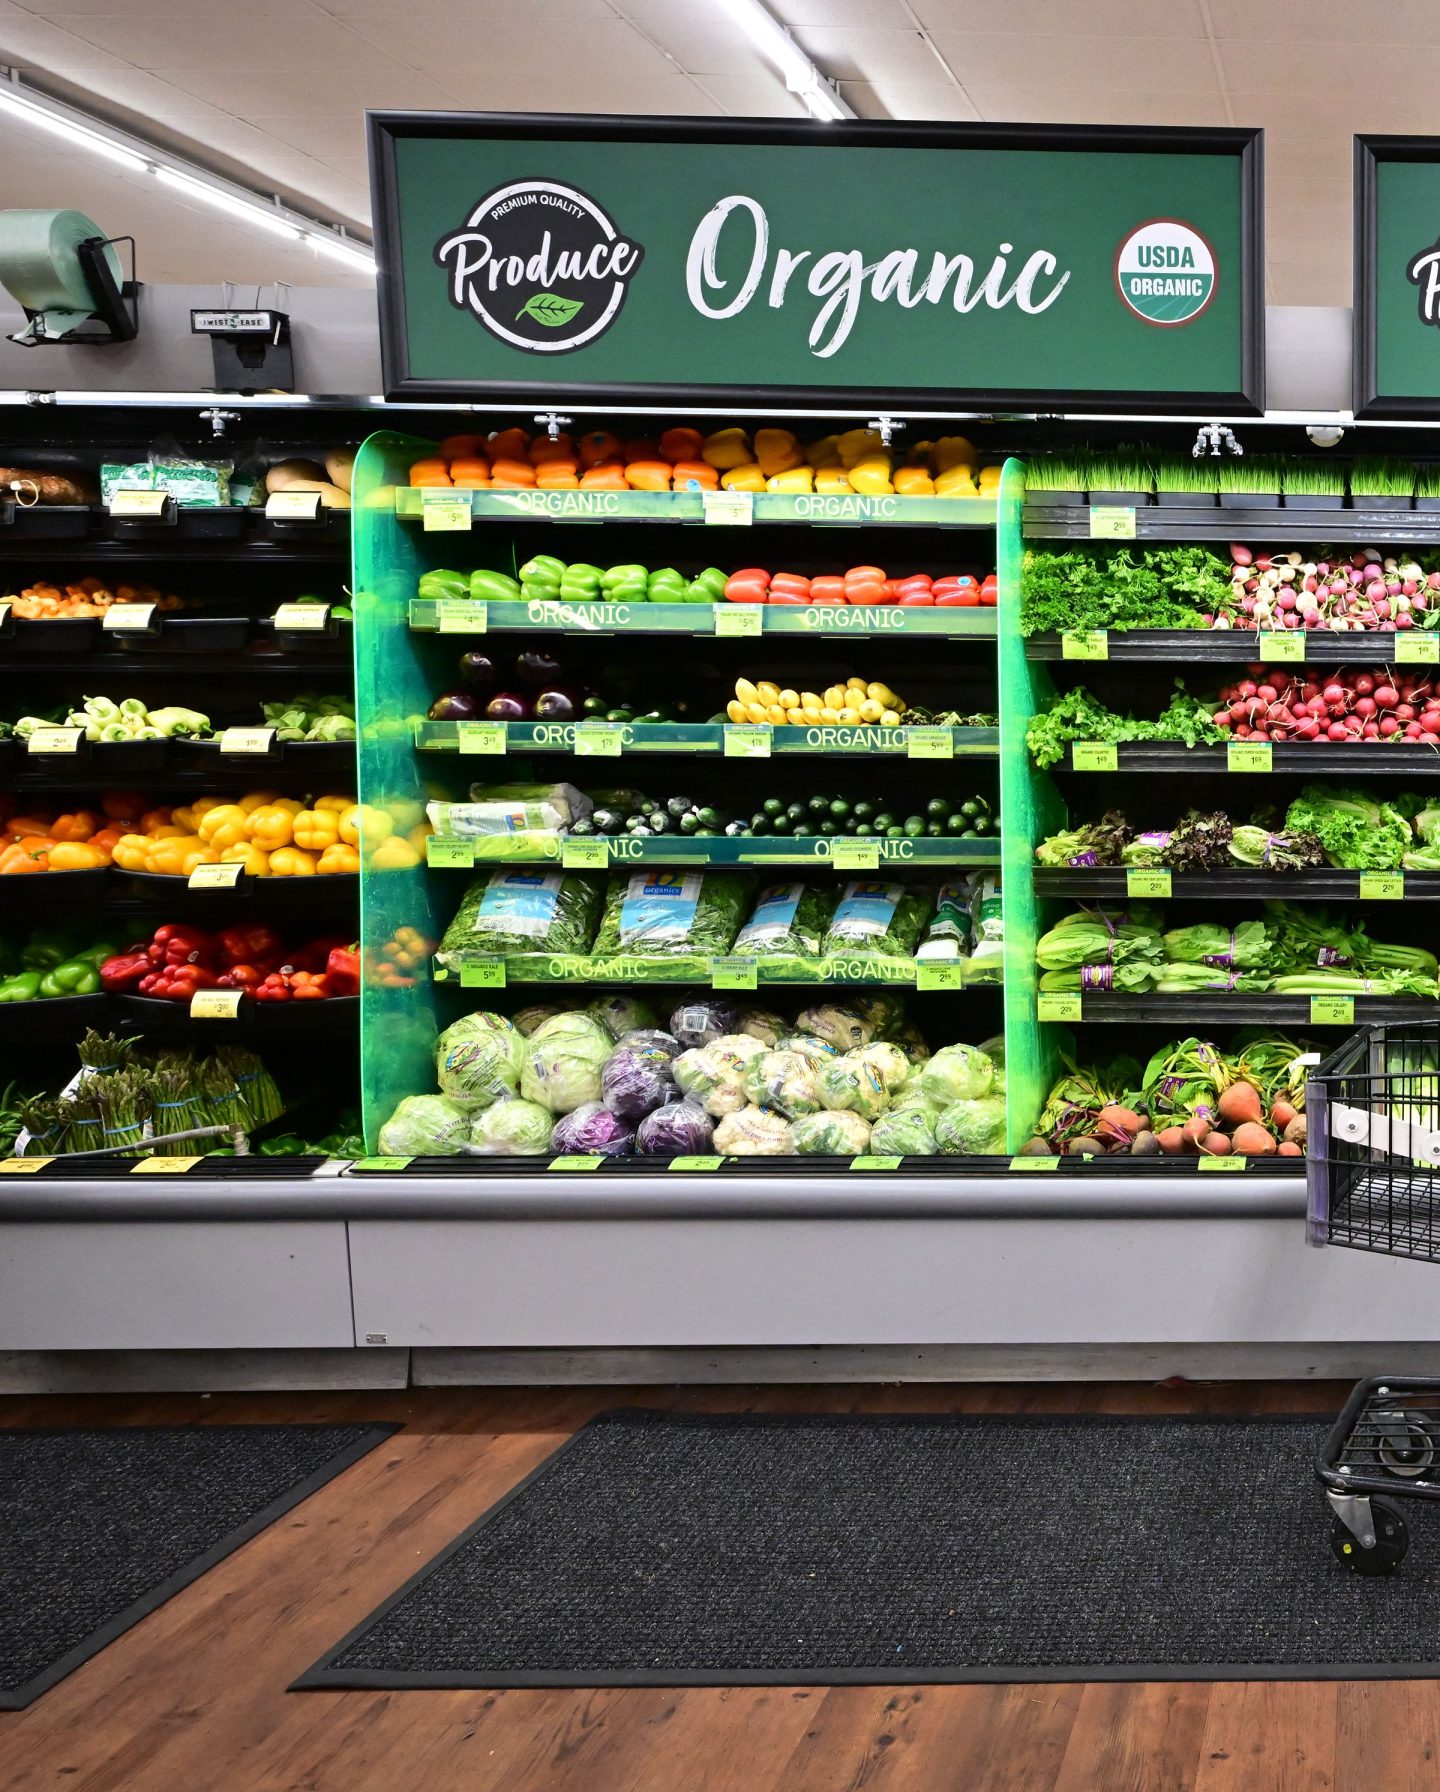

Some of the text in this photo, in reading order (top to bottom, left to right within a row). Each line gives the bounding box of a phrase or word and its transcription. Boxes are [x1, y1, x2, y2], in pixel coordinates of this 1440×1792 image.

[491, 195, 585, 220] PREMIUM QUALITY
[439, 230, 639, 304] Produce
[1137, 245, 1195, 269] USDA
[686, 195, 1071, 358] Organic
[1130, 277, 1203, 297] ORGANIC
[517, 492, 619, 513] ORGANIC
[795, 497, 896, 517] ORGANIC
[528, 605, 630, 625] ORGANIC
[804, 608, 905, 628] ORGANIC
[533, 725, 634, 745] ORGC
[806, 728, 908, 748] ORGANIC
[550, 959, 648, 978] ORGANIC
